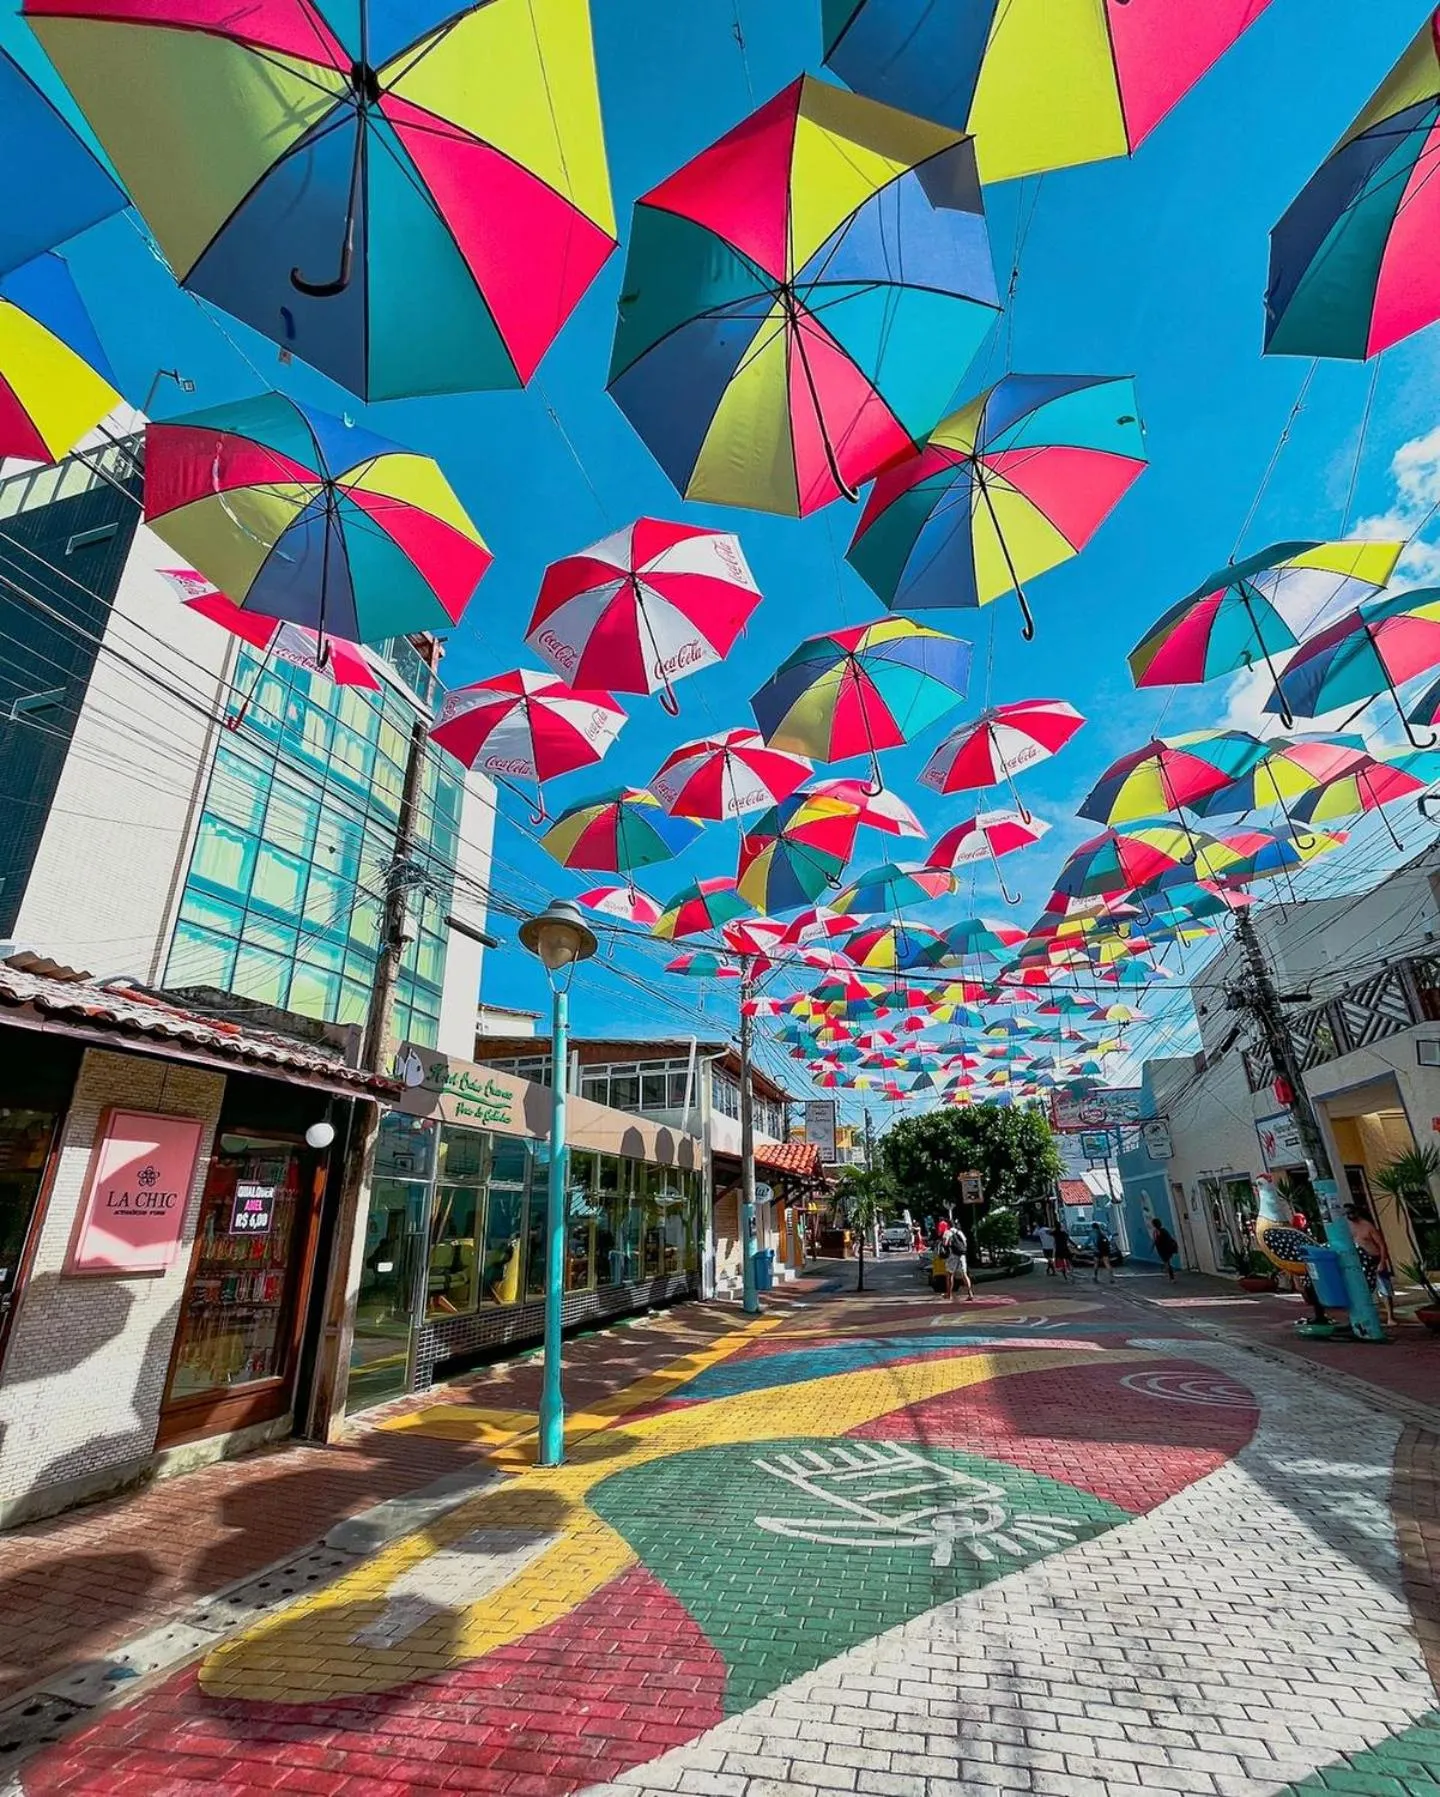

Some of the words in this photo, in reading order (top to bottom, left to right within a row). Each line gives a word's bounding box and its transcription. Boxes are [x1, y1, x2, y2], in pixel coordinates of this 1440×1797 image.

[106, 1191, 129, 1208] LA
[135, 1192, 177, 1209] CHIC
[244, 1199, 264, 1211] ANEL
[235, 1212, 249, 1229] R$
